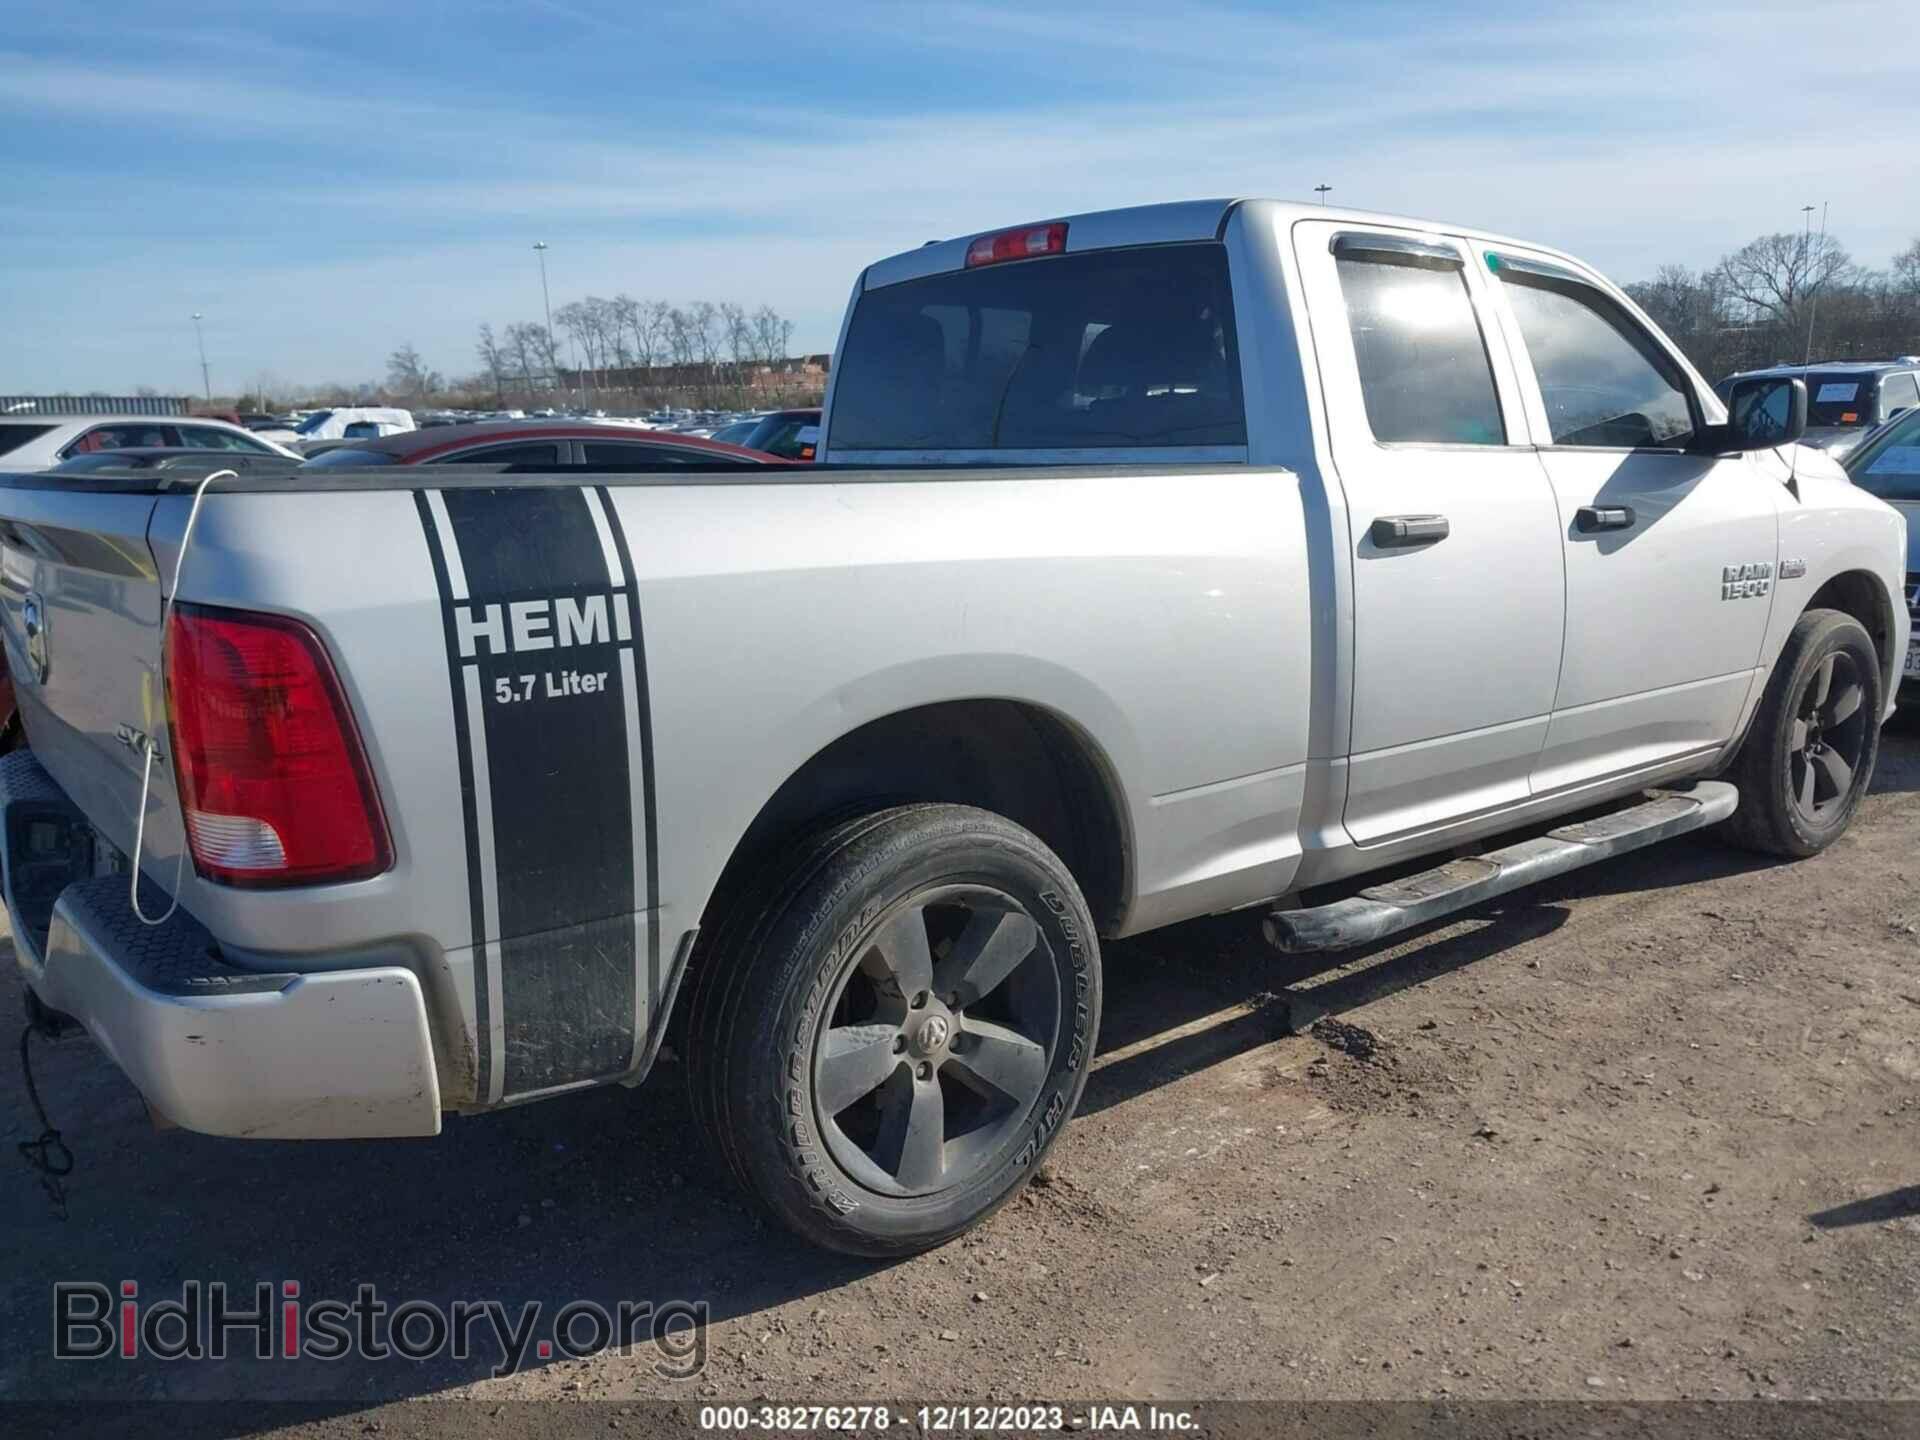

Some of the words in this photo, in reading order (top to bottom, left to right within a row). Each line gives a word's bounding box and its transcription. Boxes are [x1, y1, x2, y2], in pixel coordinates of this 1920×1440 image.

[1722, 562, 1772, 583] RAM
[1721, 580, 1769, 601] 1500
[455, 593, 632, 657] HEMI
[495, 674, 536, 703] 5.7
[545, 670, 608, 698] Liter
